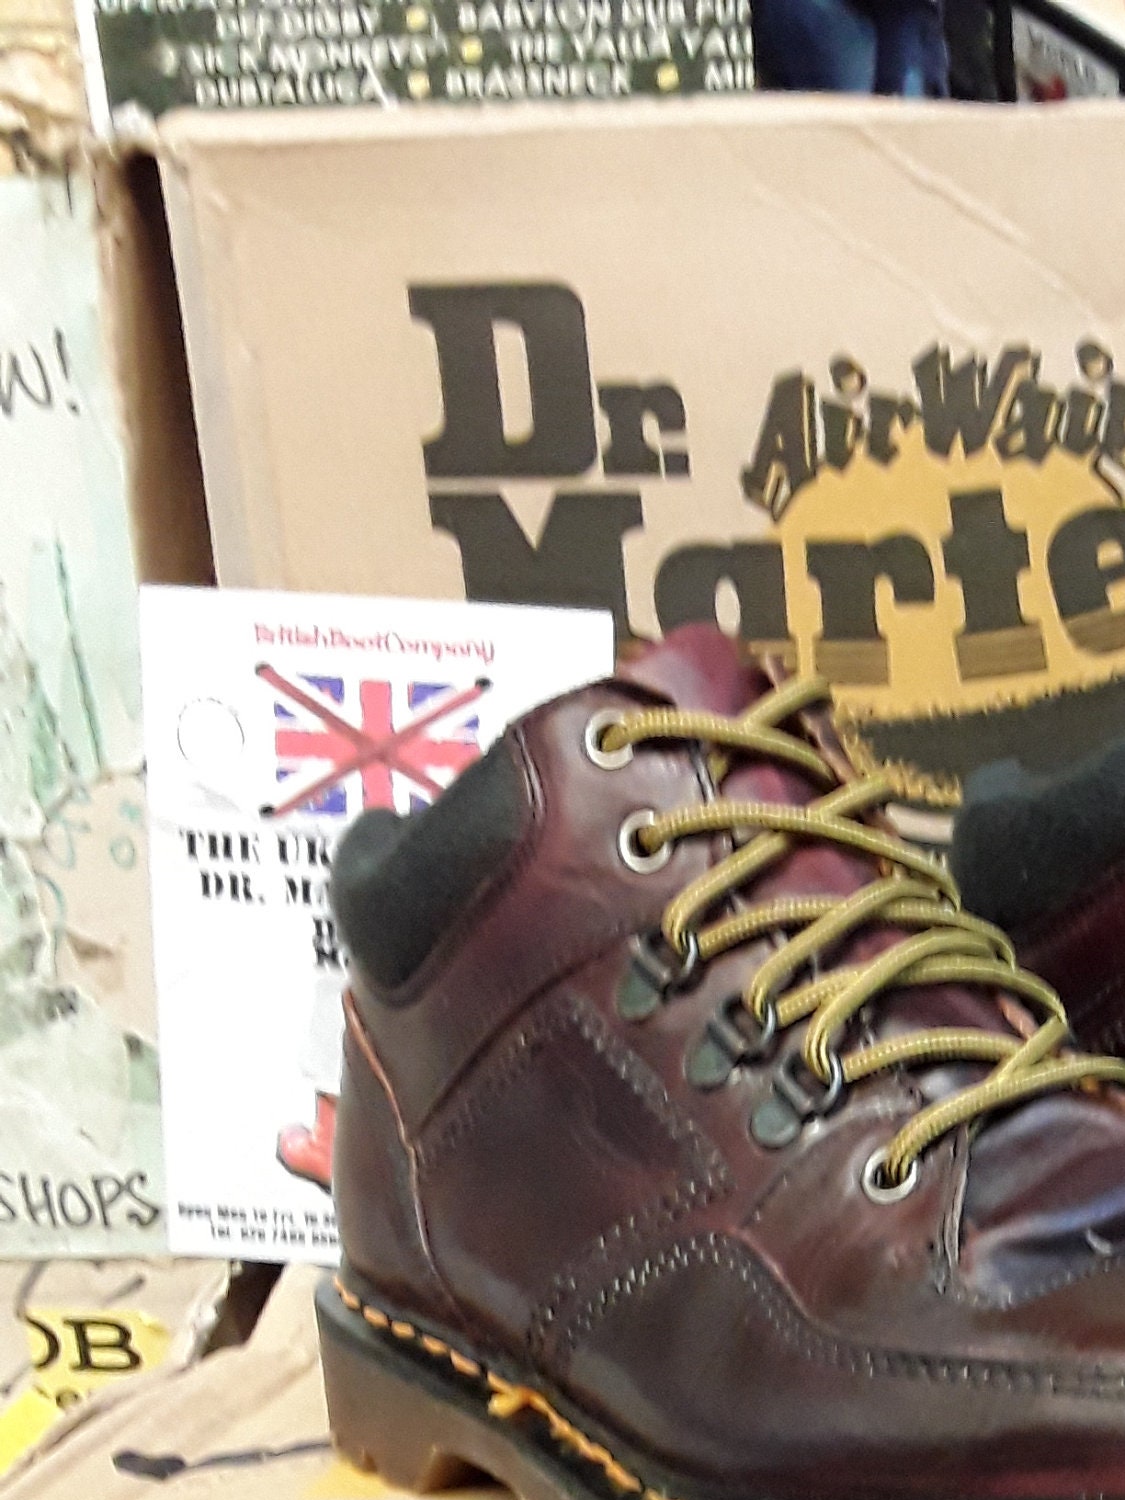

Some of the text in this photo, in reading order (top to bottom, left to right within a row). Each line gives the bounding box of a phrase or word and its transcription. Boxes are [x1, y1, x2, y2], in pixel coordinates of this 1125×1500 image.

[408, 280, 690, 479] Dr.
[178, 826, 260, 864] THE
[200, 868, 265, 905] DR.
